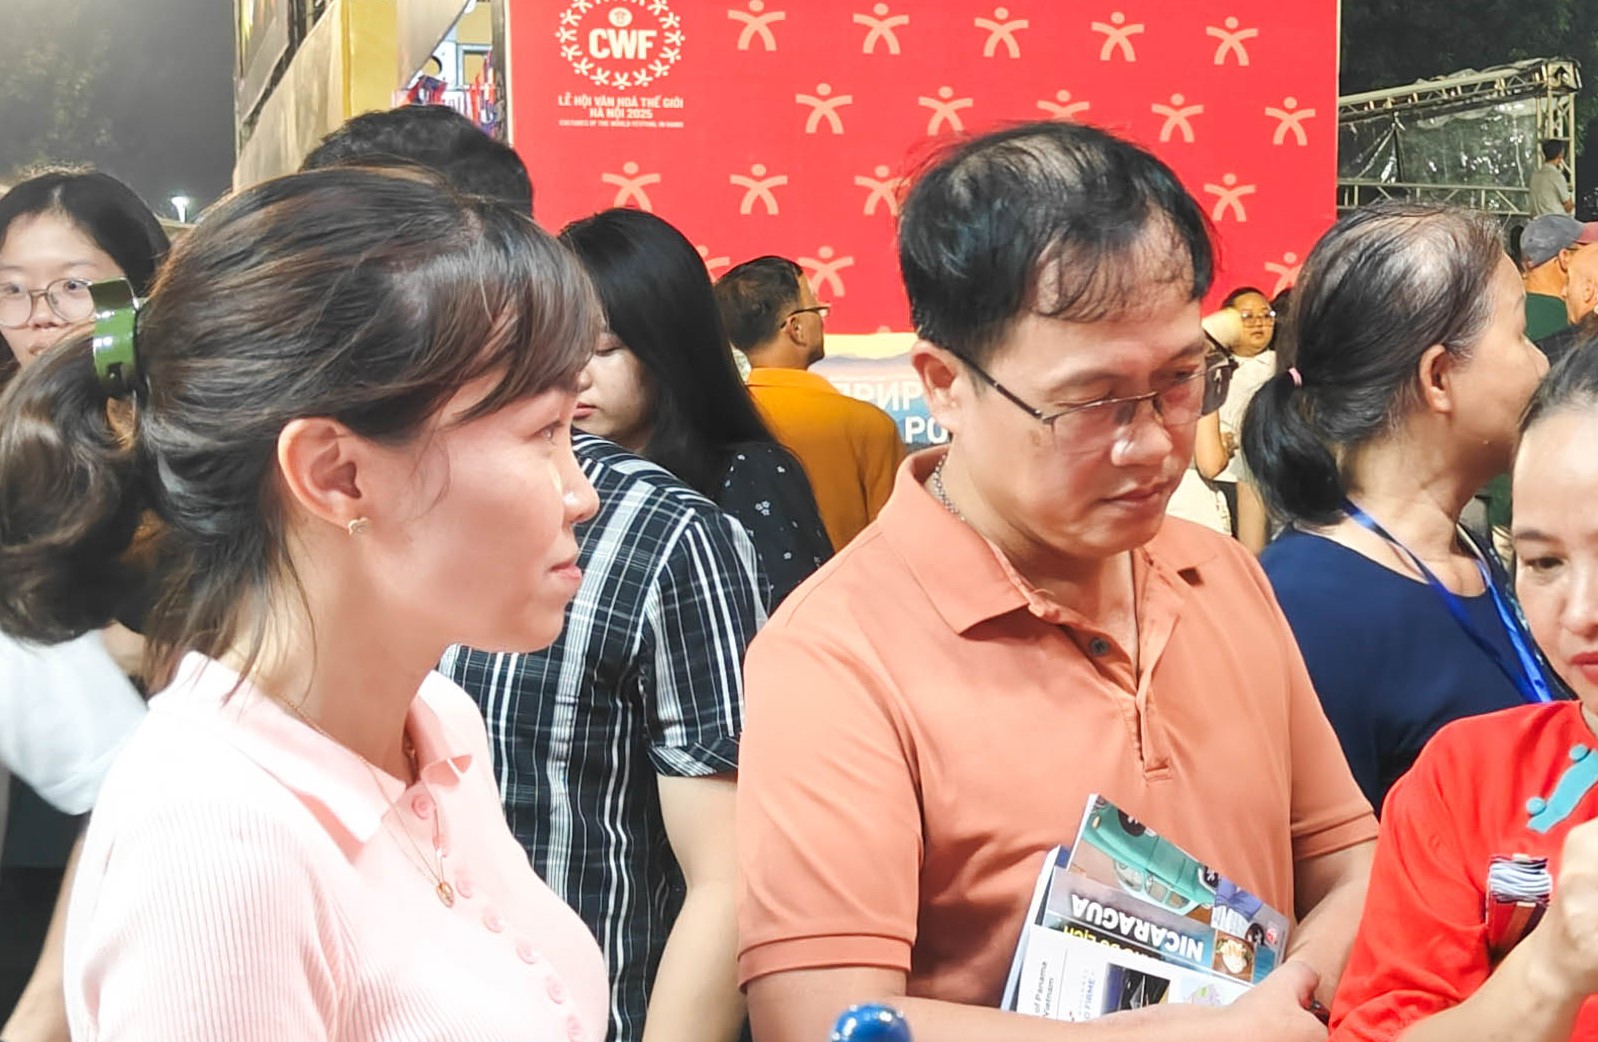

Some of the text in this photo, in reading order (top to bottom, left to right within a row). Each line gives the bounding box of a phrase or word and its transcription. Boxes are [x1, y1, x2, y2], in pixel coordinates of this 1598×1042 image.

[589, 29, 657, 59] CWF
[626, 108, 653, 119] 2025
[1070, 894, 1204, 962] NICARAGUA
[1034, 961, 1047, 1002] Panama
[1042, 977, 1055, 1017] Vietnam
